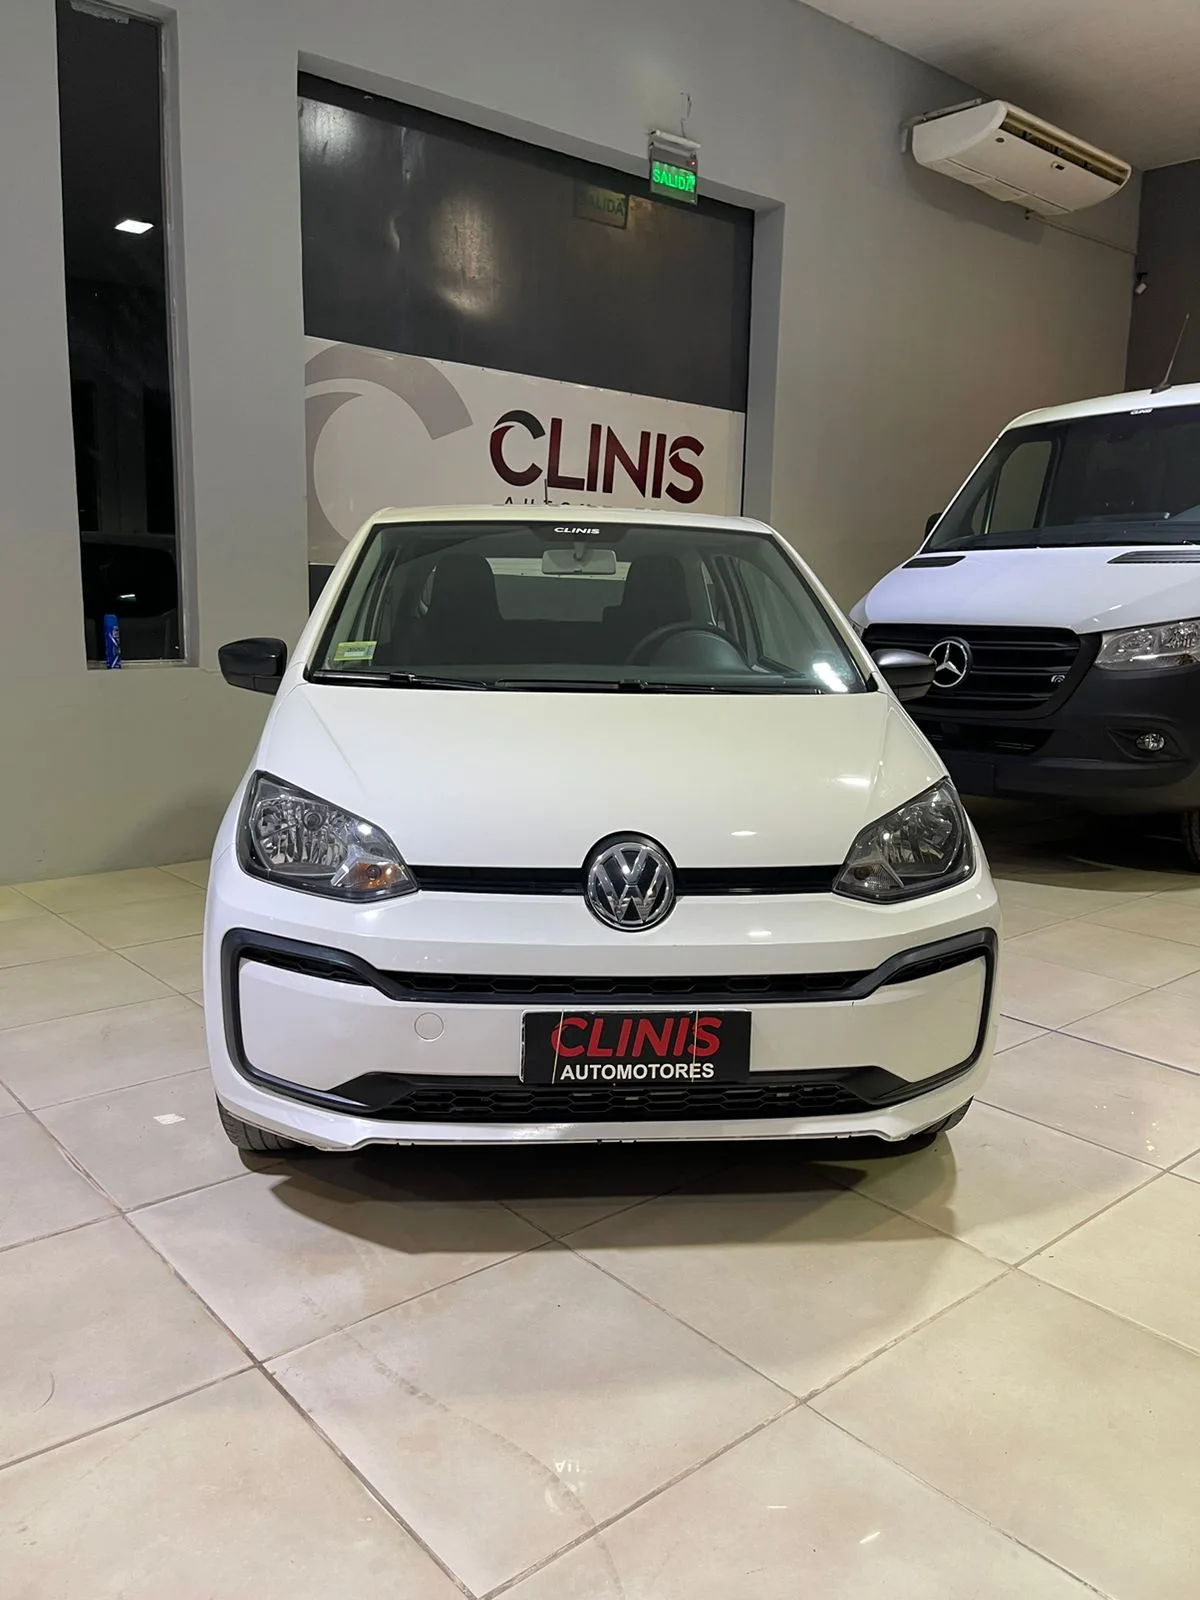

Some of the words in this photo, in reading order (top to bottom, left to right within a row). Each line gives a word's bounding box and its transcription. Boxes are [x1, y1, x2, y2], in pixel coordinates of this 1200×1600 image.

[653, 168, 696, 192] SALIDA
[489, 409, 705, 504] CLINIS
[553, 526, 601, 535] CLINIS
[551, 1016, 722, 1058] CLINIS
[560, 1062, 715, 1081] AUTOMOTORES
